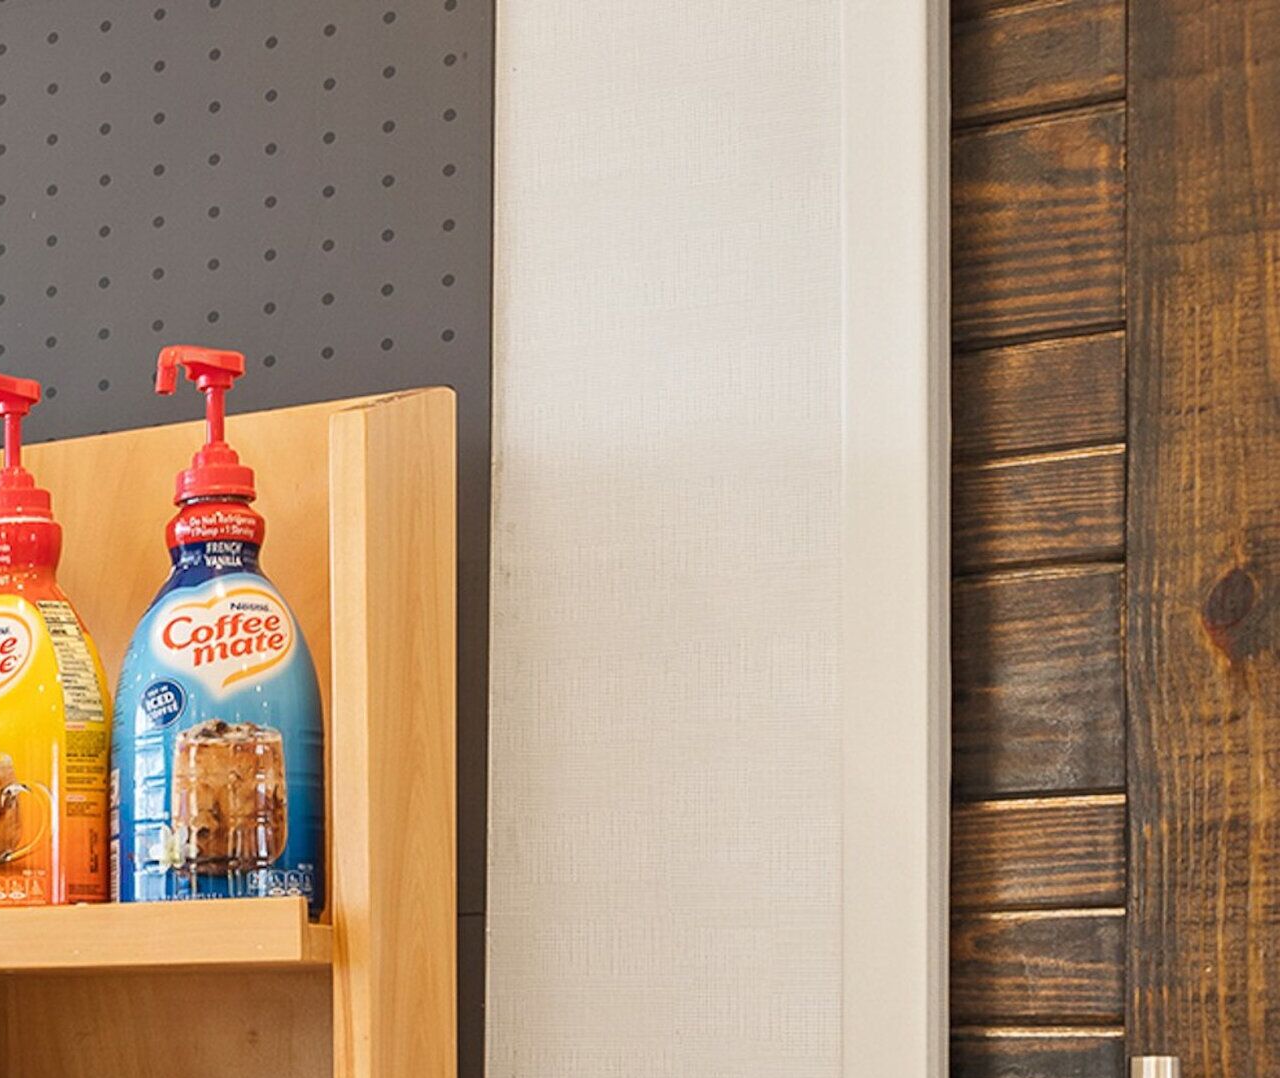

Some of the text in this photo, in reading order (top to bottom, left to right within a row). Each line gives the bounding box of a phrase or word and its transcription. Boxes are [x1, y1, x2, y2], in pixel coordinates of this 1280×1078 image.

[205, 541, 244, 554] FRENCH
[203, 554, 244, 567] VANILLA
[162, 613, 281, 650] Coffee
[193, 632, 285, 667] mate
